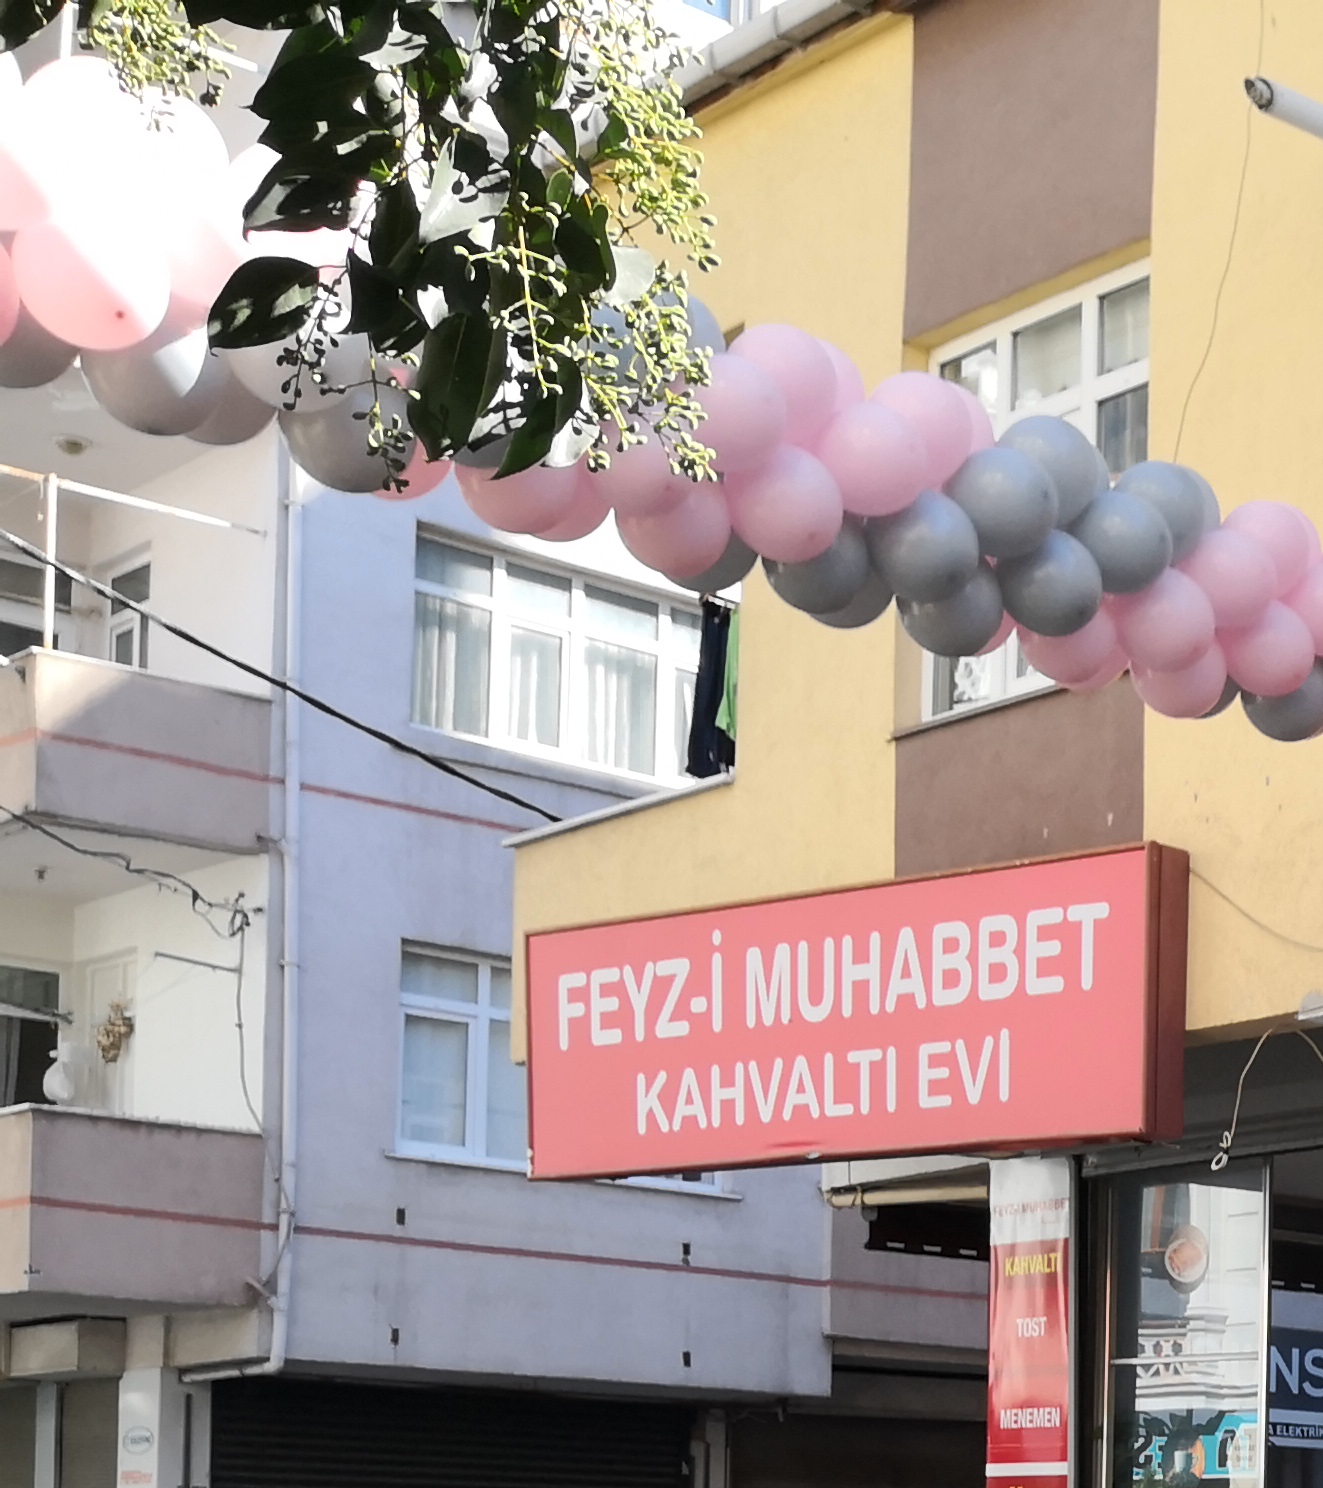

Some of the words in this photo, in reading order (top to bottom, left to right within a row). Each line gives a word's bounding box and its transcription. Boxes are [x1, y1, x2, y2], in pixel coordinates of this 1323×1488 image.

[558, 929, 723, 1051] FEYZ-İ
[746, 902, 1110, 1029] MUHABBET
[636, 1045, 897, 1135] KAHVALTI
[1004, 1252, 1061, 1277] KAHVALTI
[1016, 1316, 1047, 1337] TOST
[999, 1407, 1061, 1430] MENEMEN
